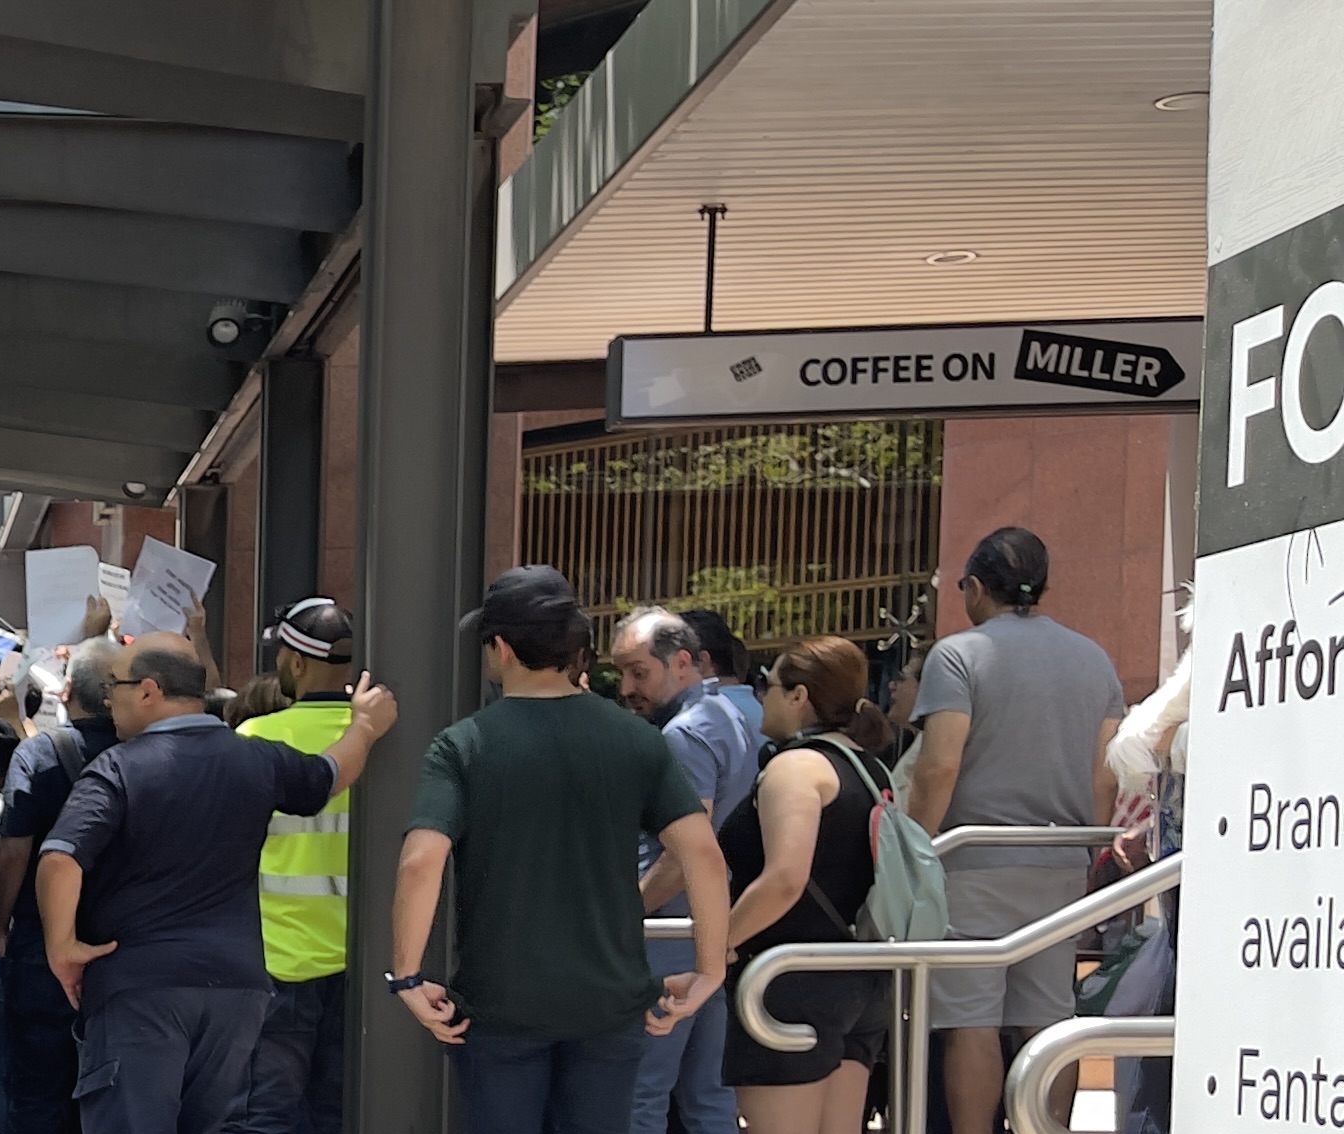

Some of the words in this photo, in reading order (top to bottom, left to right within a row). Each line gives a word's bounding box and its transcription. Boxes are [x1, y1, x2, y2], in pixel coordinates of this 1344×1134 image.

[800, 354, 934, 387] COFFEE
[943, 352, 995, 382] ON
[1026, 340, 1162, 388] MILLER
[1227, 280, 1344, 488] FO
[1218, 618, 1344, 713] Affor
